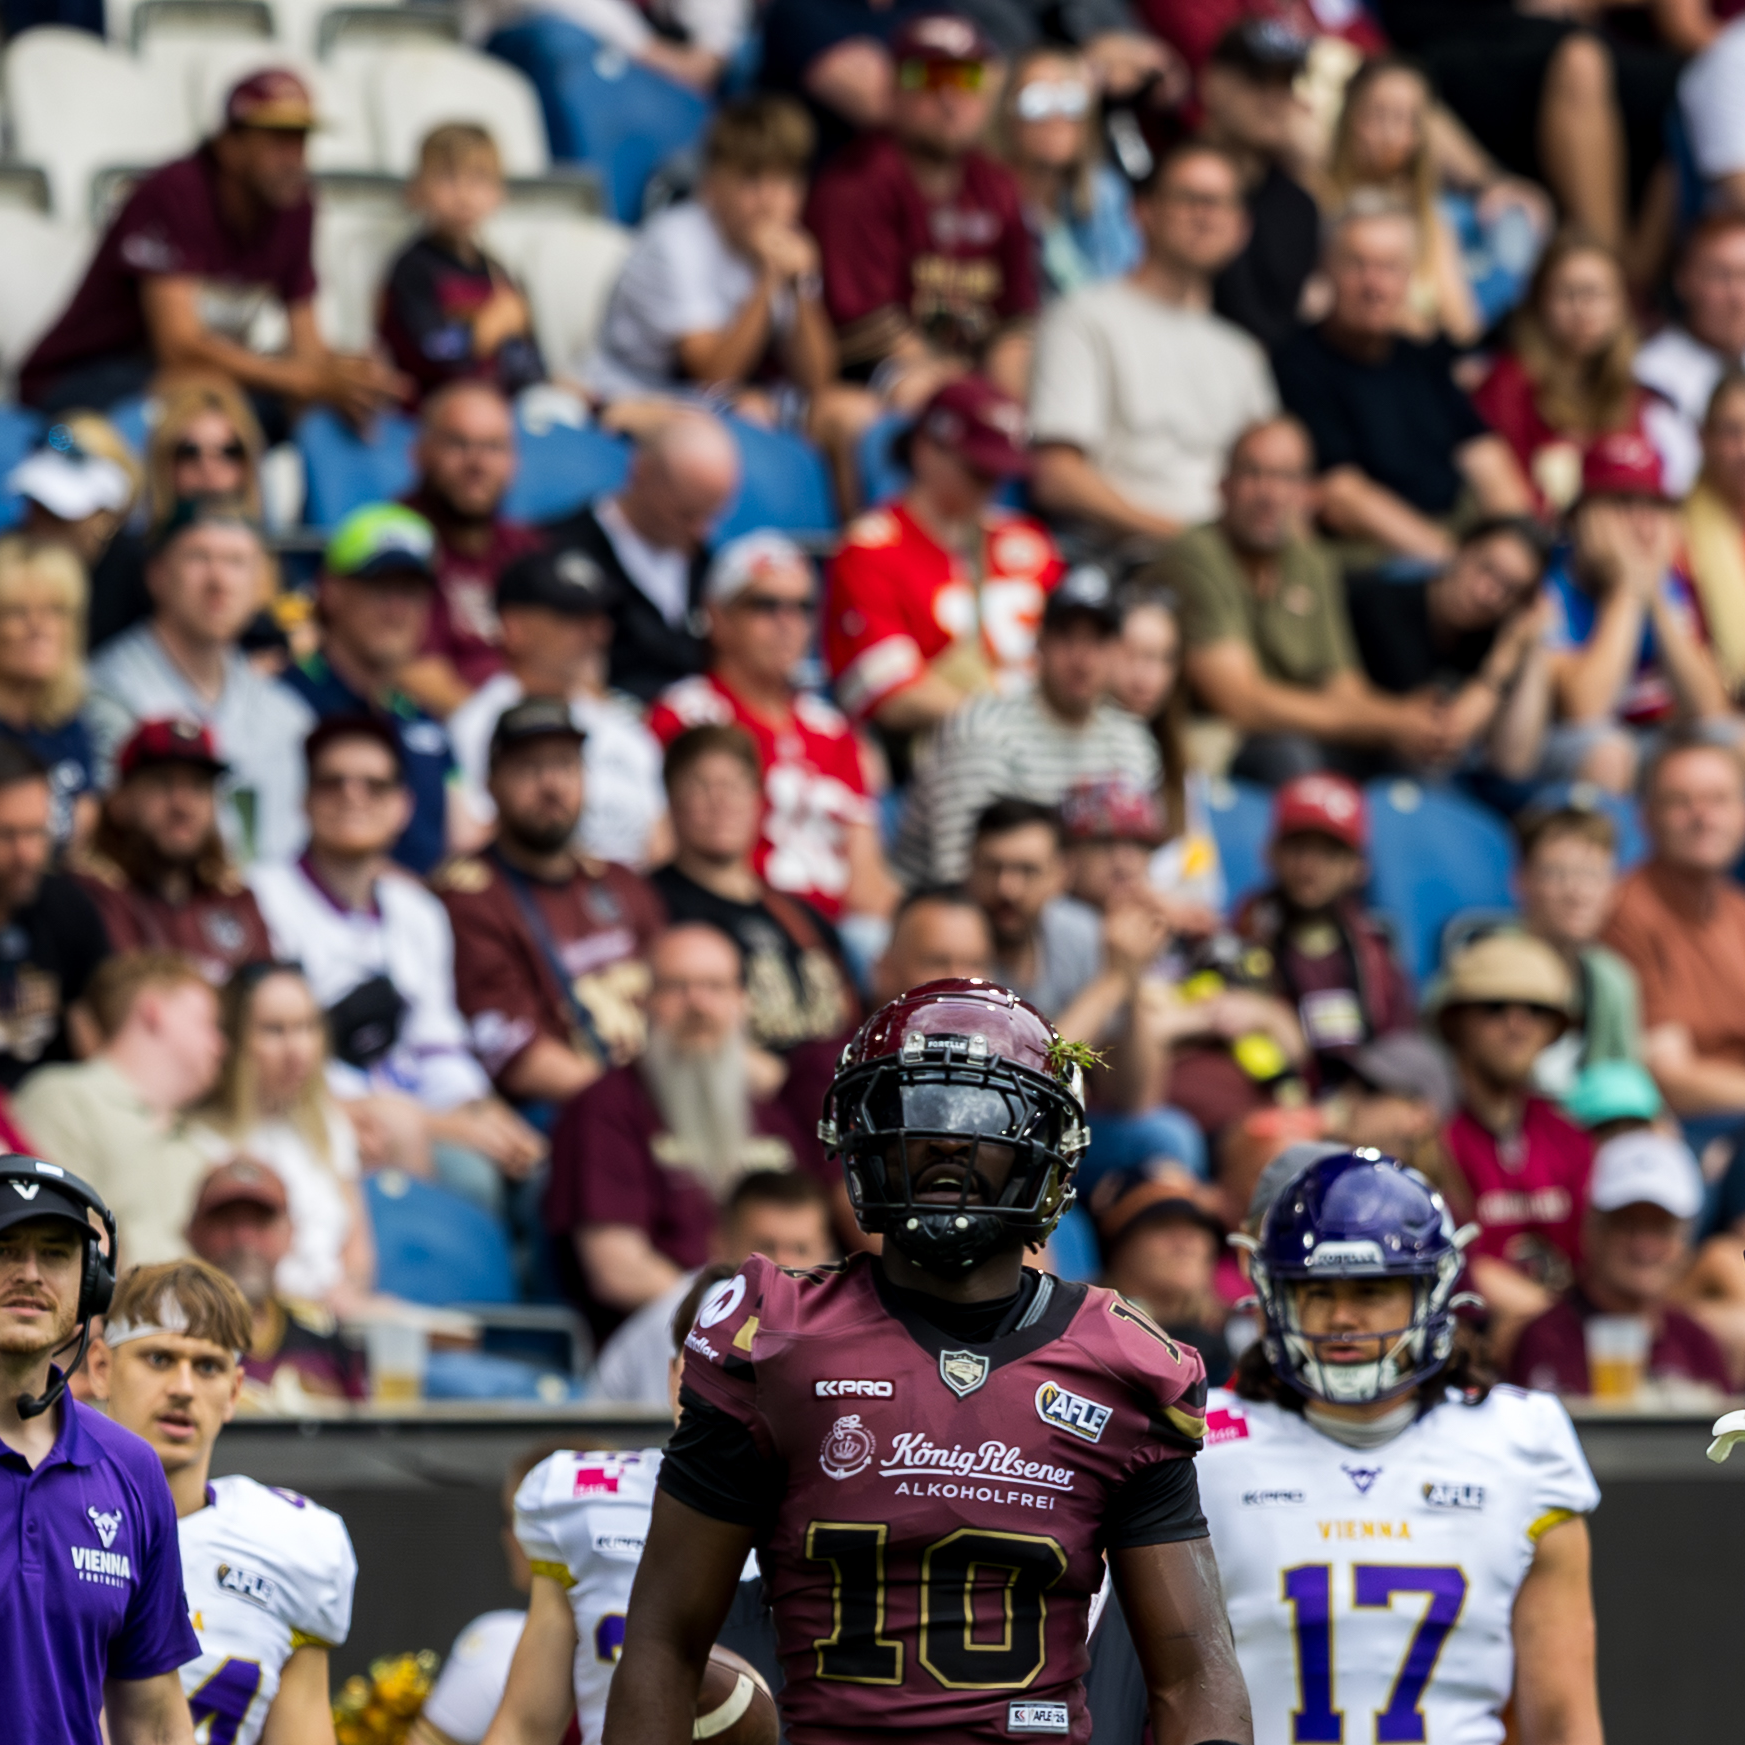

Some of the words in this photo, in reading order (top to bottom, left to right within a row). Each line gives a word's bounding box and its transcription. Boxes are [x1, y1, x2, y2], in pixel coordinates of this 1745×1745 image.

[928, 1040, 966, 1050] FORELLE
[1046, 1392, 1107, 1433] AFLE
[880, 1433, 974, 1476] König
[972, 1440, 1075, 1486] Pilsener
[894, 1482, 1055, 1510] ALKOHOLFREI
[1318, 1520, 1412, 1542] VIENNA
[71, 1547, 131, 1580] VIENNA
[78, 1570, 125, 1590] FOOTBALL
[223, 1568, 275, 1603] AFLE
[806, 1521, 1068, 1690] 10
[1032, 1711, 1053, 1722] AFLE
